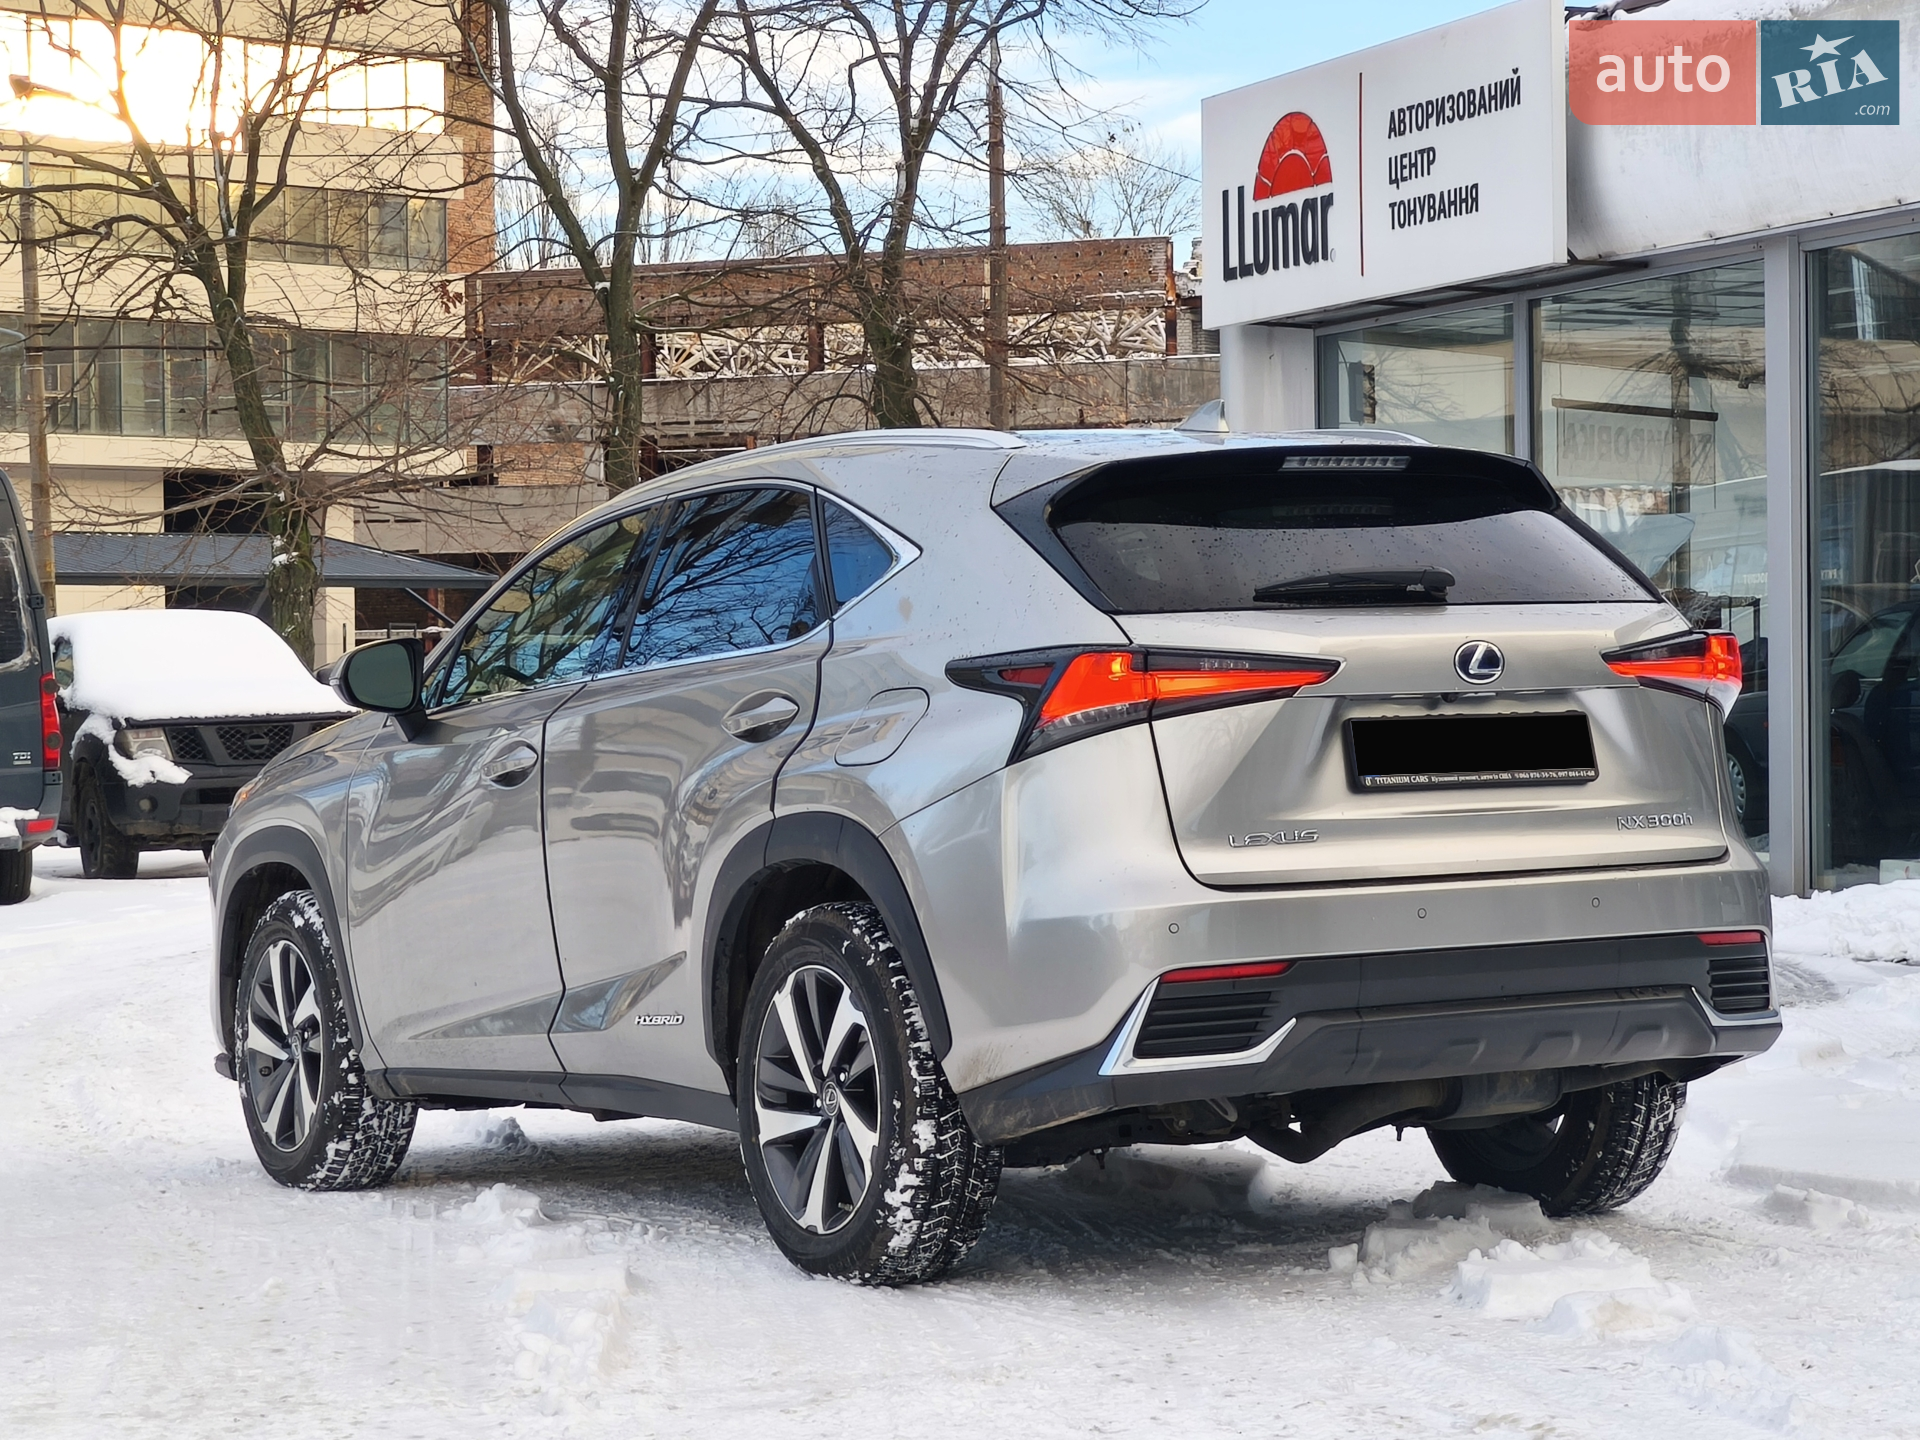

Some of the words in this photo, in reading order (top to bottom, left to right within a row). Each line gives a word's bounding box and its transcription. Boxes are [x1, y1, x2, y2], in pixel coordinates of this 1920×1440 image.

[1388, 67, 1521, 139] АВТОРИЗОВАНИЙ
[1388, 146, 1437, 190] ЦЕНТР
[1388, 182, 1479, 230] ТОНУВАННЯ
[1222, 185, 1334, 282] LLumar
[1375, 775, 1410, 785] TITANIUM
[1411, 775, 1429, 783] CARS
[1228, 828, 1319, 848] LEXUS
[634, 1015, 684, 1026] HYBRID
